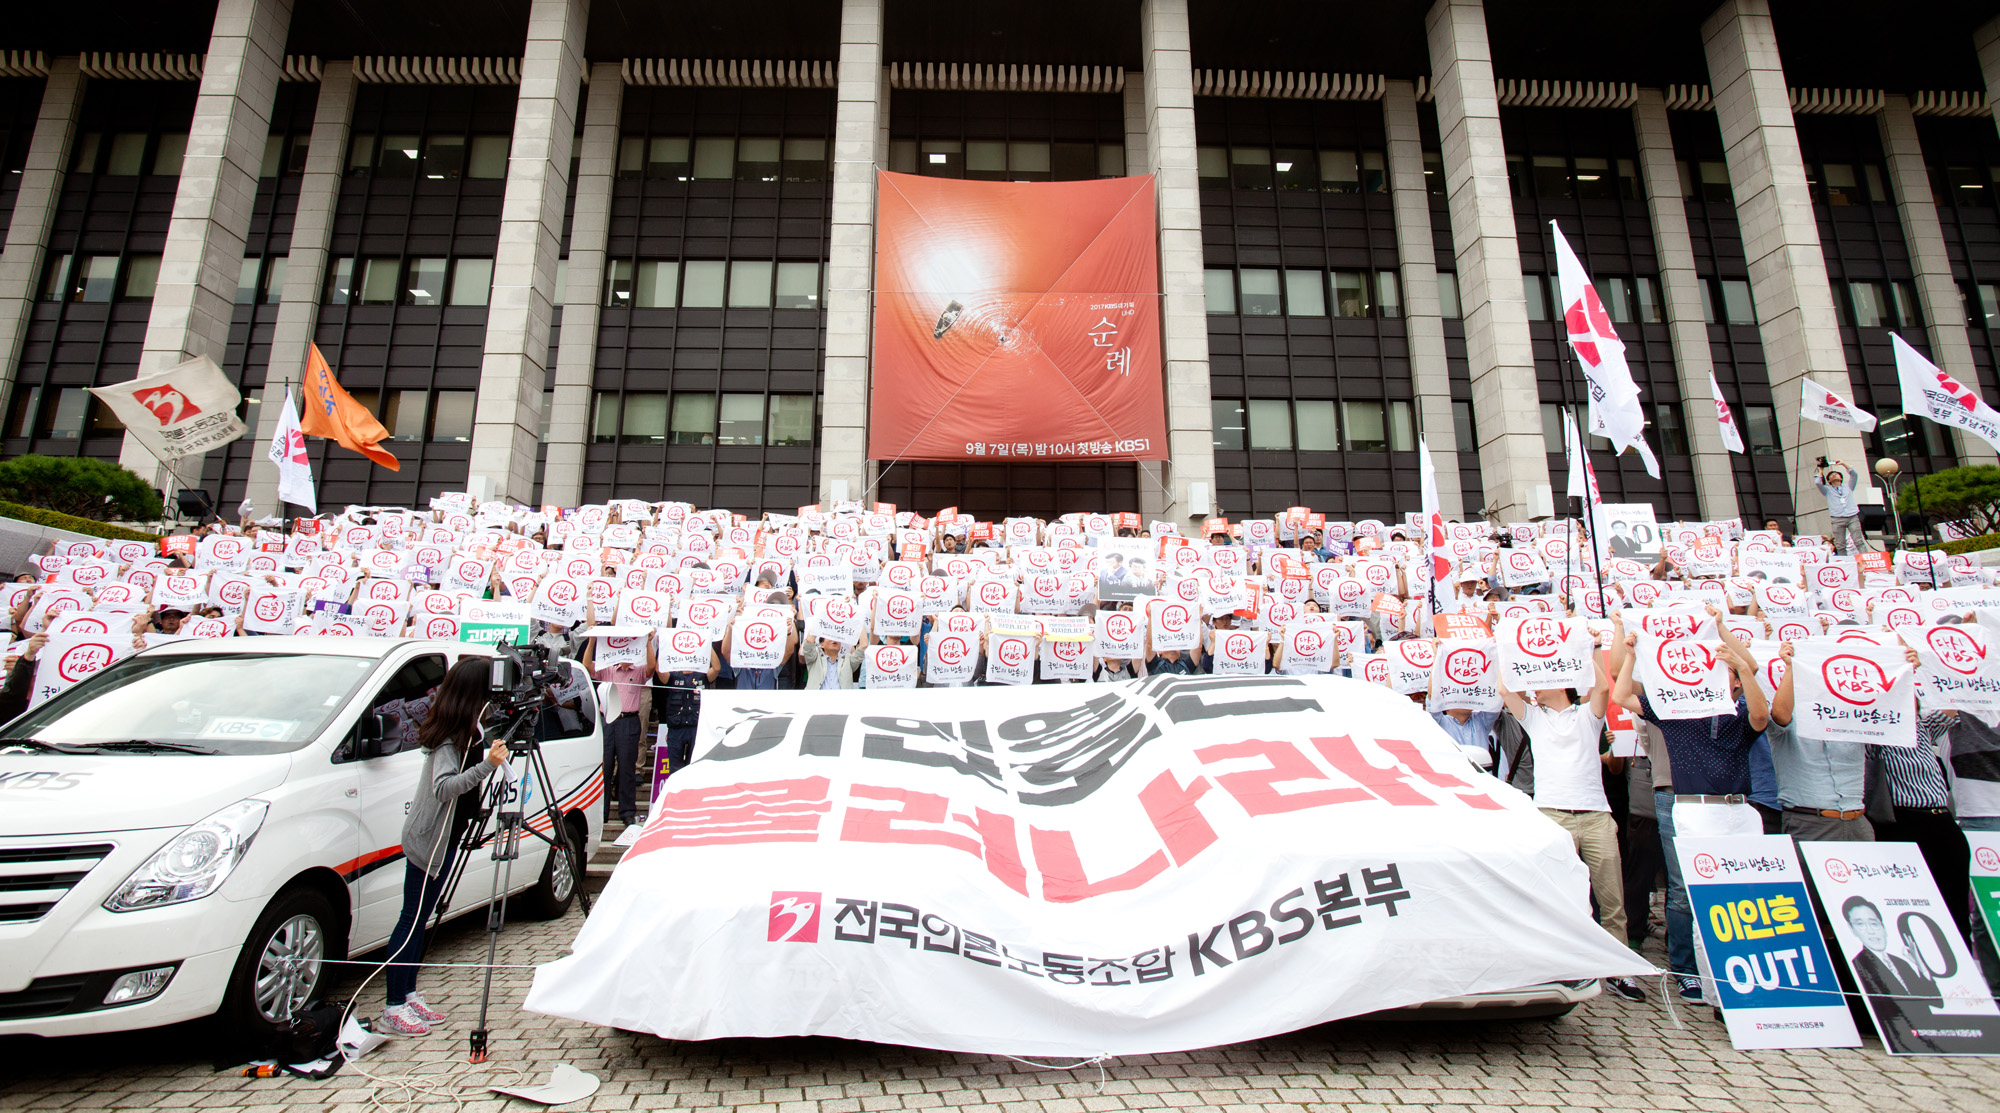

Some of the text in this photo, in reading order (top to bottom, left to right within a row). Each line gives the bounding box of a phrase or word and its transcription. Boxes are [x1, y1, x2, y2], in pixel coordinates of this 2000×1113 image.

[965, 442, 986, 456] 9월
[1035, 443, 1048, 456] 밤
[1049, 443, 1075, 456] 10시
[1077, 442, 1113, 456] 첫방송
[1115, 438, 1150, 453] KBS1
[537, 601, 575, 617] 국민의 방송으로!
[694, 606, 710, 614] 다시
[831, 602, 846, 611] 다시
[624, 614, 663, 627] 국민의 방송으로!
[1167, 611, 1182, 619] 다시
[1447, 614, 1477, 626] 퇴진!
[818, 619, 855, 635] 국민의 방송으로!
[880, 619, 918, 628] 국민의 방송으로!
[1112, 620, 1127, 628] 다시
[1653, 617, 1680, 626] 다시
[70, 625, 97, 634] 다시
[1526, 623, 1551, 635] 다시
[1157, 633, 1195, 643] 국민의 방송으로!
[1299, 636, 1314, 644] 다시
[1936, 637, 1963, 648] 다시
[944, 643, 959, 651] 다시
[1005, 644, 1021, 652] 다시
[1060, 642, 1075, 650] 다시
[1100, 640, 1139, 650] 국민의 방송으로!
[1407, 642, 1428, 652] 다시
[73, 650, 100, 661] 다시
[602, 649, 642, 661] 국민의 방송으로!
[738, 649, 780, 660] 국민의 방송으로!
[1668, 647, 1695, 659] 다시
[666, 655, 708, 665] 국민의 방송으로!
[1287, 656, 1326, 664] 국민의 방송으로!
[1455, 657, 1477, 665] 다시
[932, 664, 973, 674] 국민의 방송으로!
[990, 665, 1028, 678] 국민의 방송으로!
[1047, 661, 1088, 672] 국민의 방송으로!
[1219, 661, 1259, 671] 국민의 방송으로!
[1512, 659, 1582, 676] 국민의 방송으로!
[870, 672, 911, 683] 국민의 방송으로!
[1400, 671, 1422, 681] 국민의
[1834, 666, 1868, 678] 다시
[1933, 676, 1963, 692] 국민의
[1462, 686, 1495, 697] 방송으로!
[1657, 688, 1725, 703] 국민의 방송으로!
[1813, 703, 1900, 724] 국민의 방송으로!
[215, 722, 260, 734] KBS
[620, 734, 1510, 905] 물러나라!
[1721, 857, 1785, 874] 국민의 방송으로!
[1852, 864, 1919, 879] 국민의 방송으로!
[1188, 862, 1412, 977] KBS본부
[1709, 894, 1806, 943] 이인호
[1724, 945, 1820, 995] OUT!
